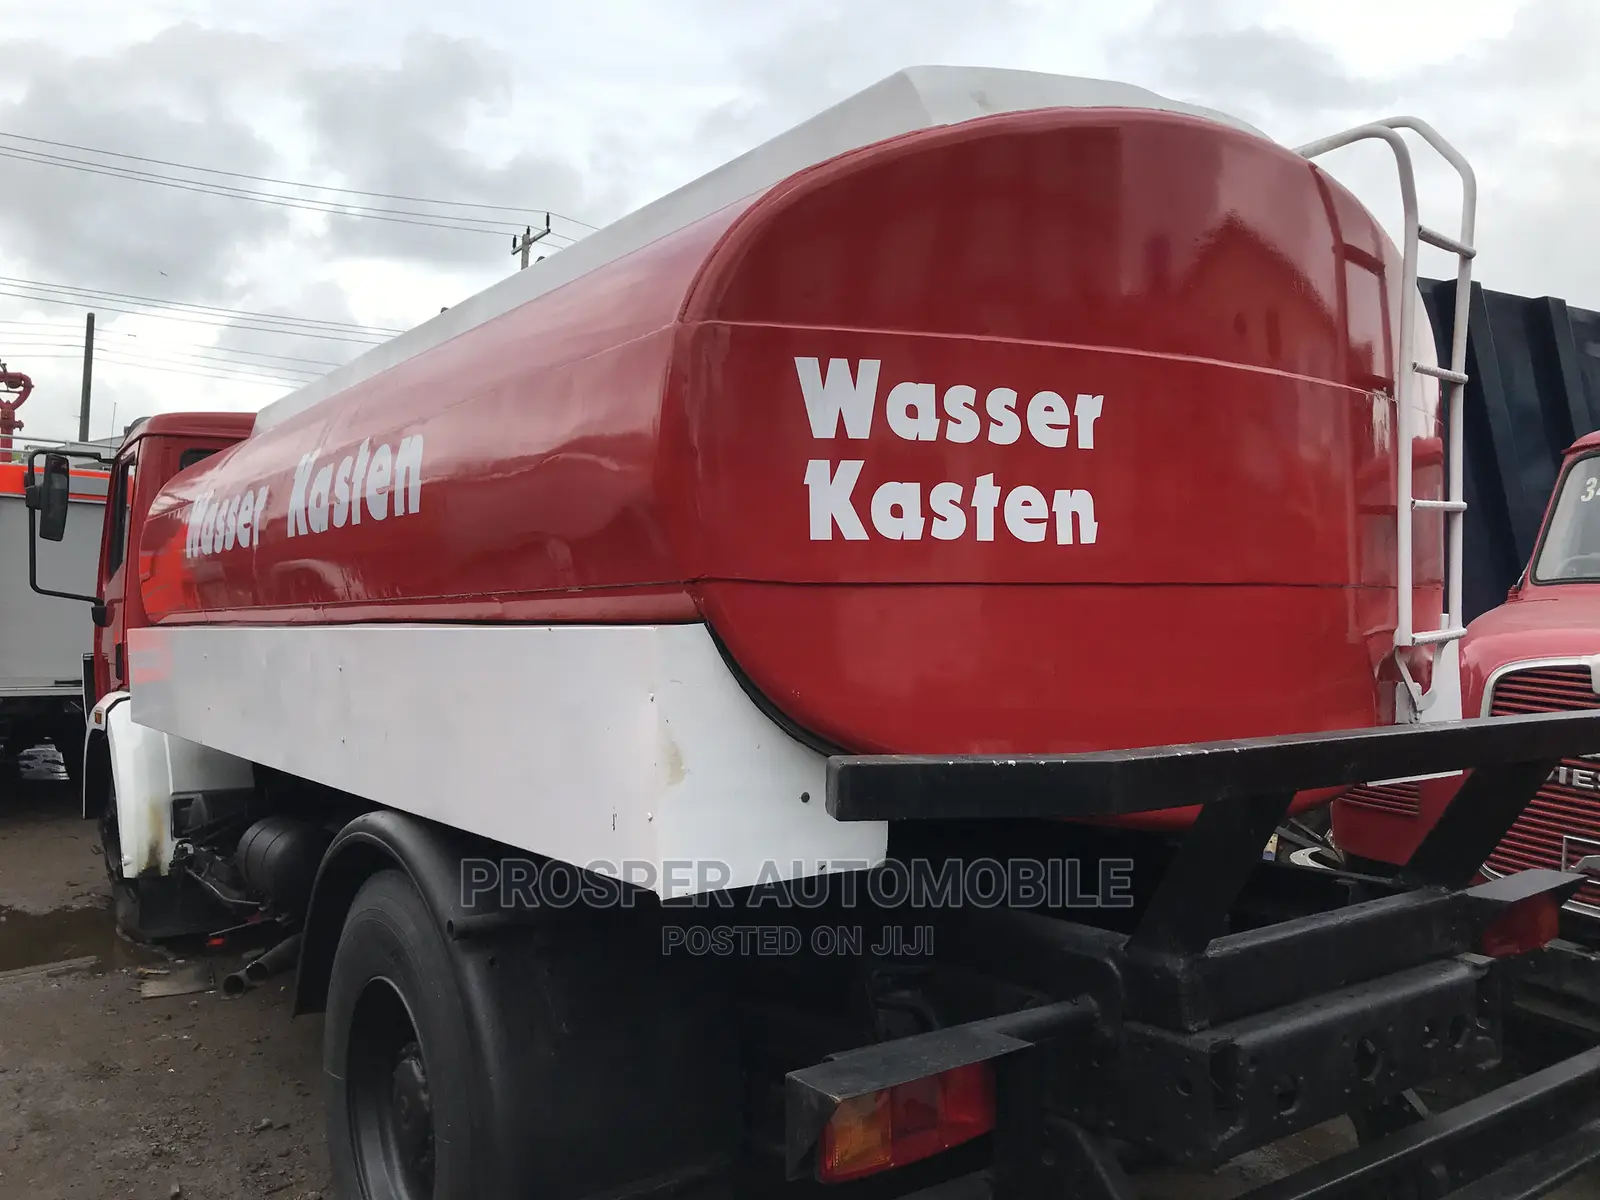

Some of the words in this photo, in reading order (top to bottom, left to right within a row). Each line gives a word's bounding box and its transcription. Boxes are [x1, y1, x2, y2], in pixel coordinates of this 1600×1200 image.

[793, 356, 1105, 449] Wasser
[186, 488, 270, 559] Wasser
[287, 433, 424, 538] Kasten
[803, 459, 1099, 545] Kasten
[1580, 477, 1600, 502] 3
